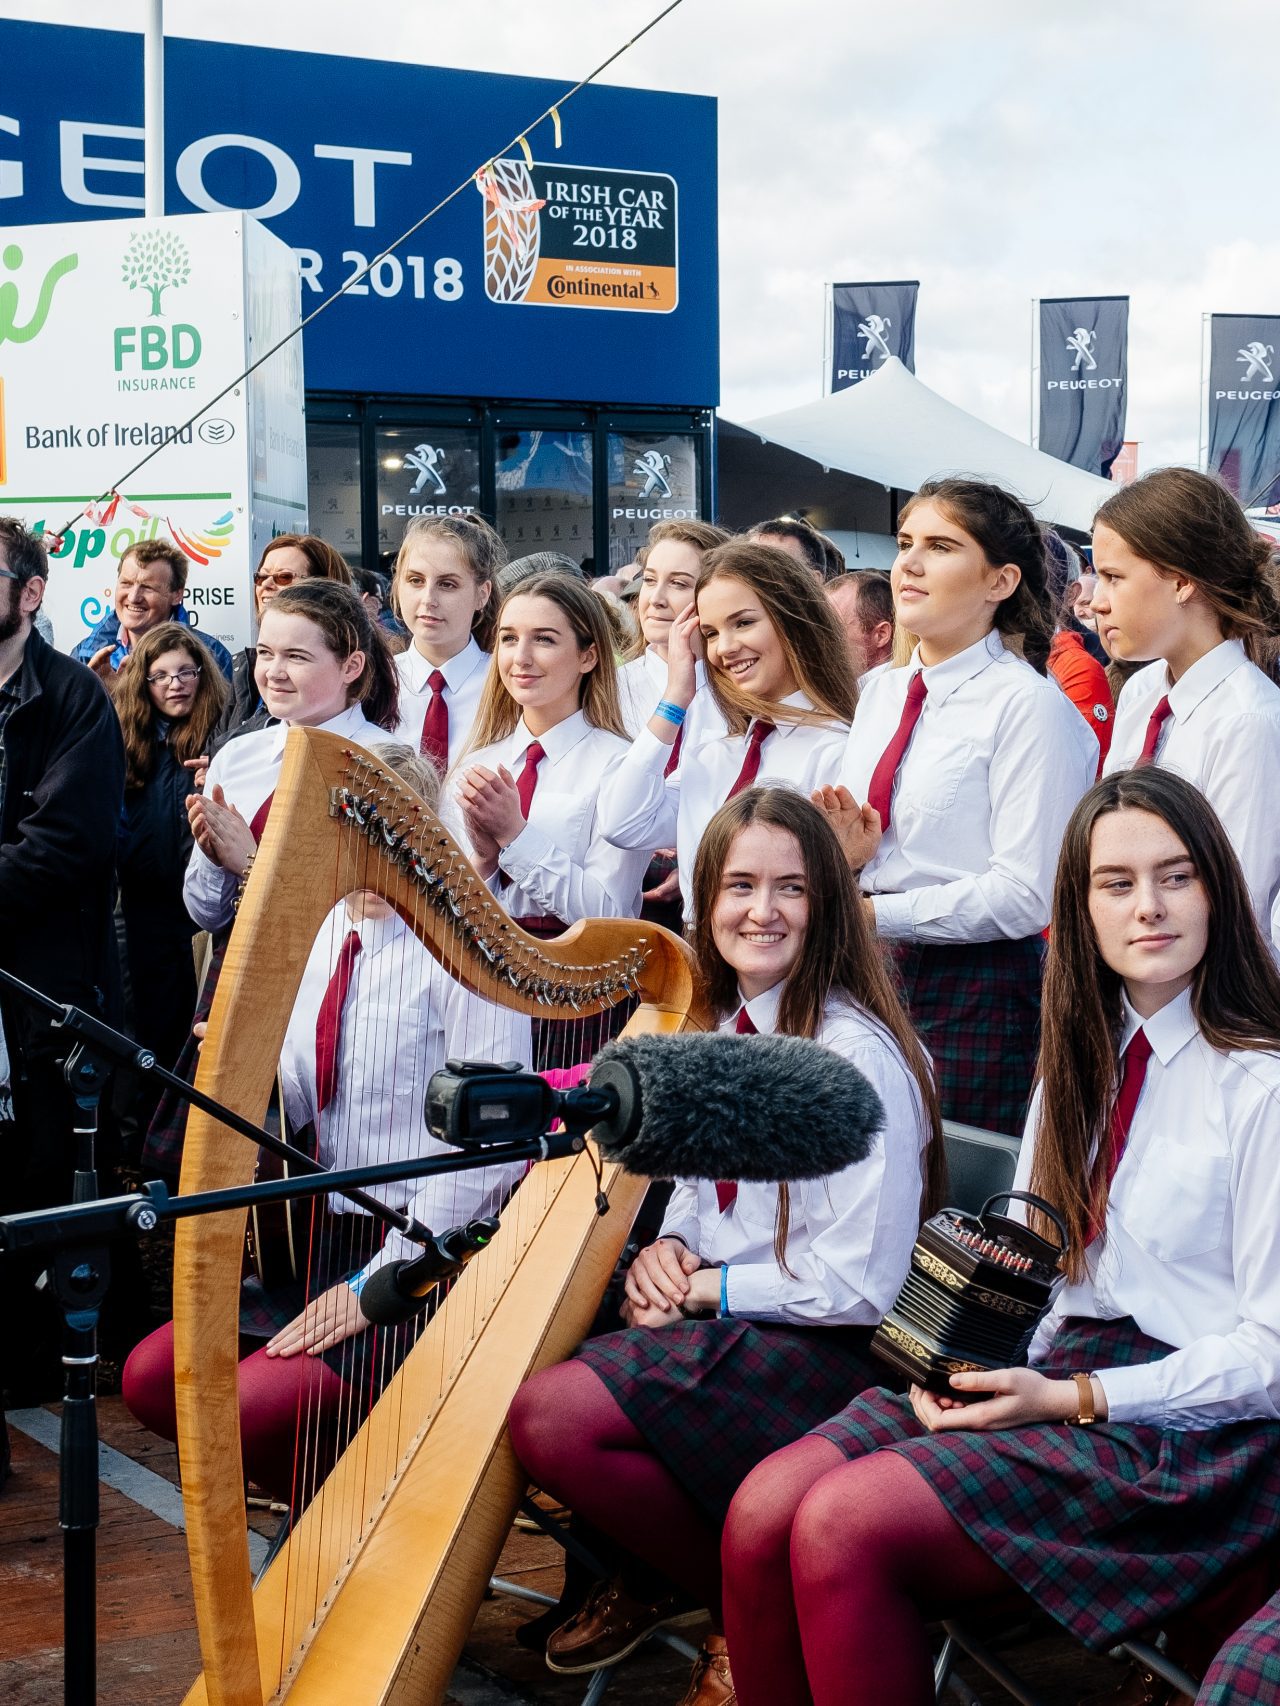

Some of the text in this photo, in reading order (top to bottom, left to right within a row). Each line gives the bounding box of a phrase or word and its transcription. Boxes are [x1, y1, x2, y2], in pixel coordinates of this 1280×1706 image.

[0, 114, 411, 227] EOT
[545, 181, 668, 210] IRISH CAR
[548, 205, 664, 229] OF THE YEAR
[572, 224, 638, 250] 2018
[341, 250, 464, 301] 2018
[565, 264, 642, 277] IN ASSOCIATION WITH
[546, 275, 644, 299] Continental
[113, 323, 202, 372] FBD
[118, 376, 196, 392] INSURANCE
[1047, 378, 1122, 391] PEUGEOT
[25, 422, 193, 449] Bank of Ireland
[381, 504, 475, 516] PEUGEOT
[612, 508, 698, 520] PEUGEOT
